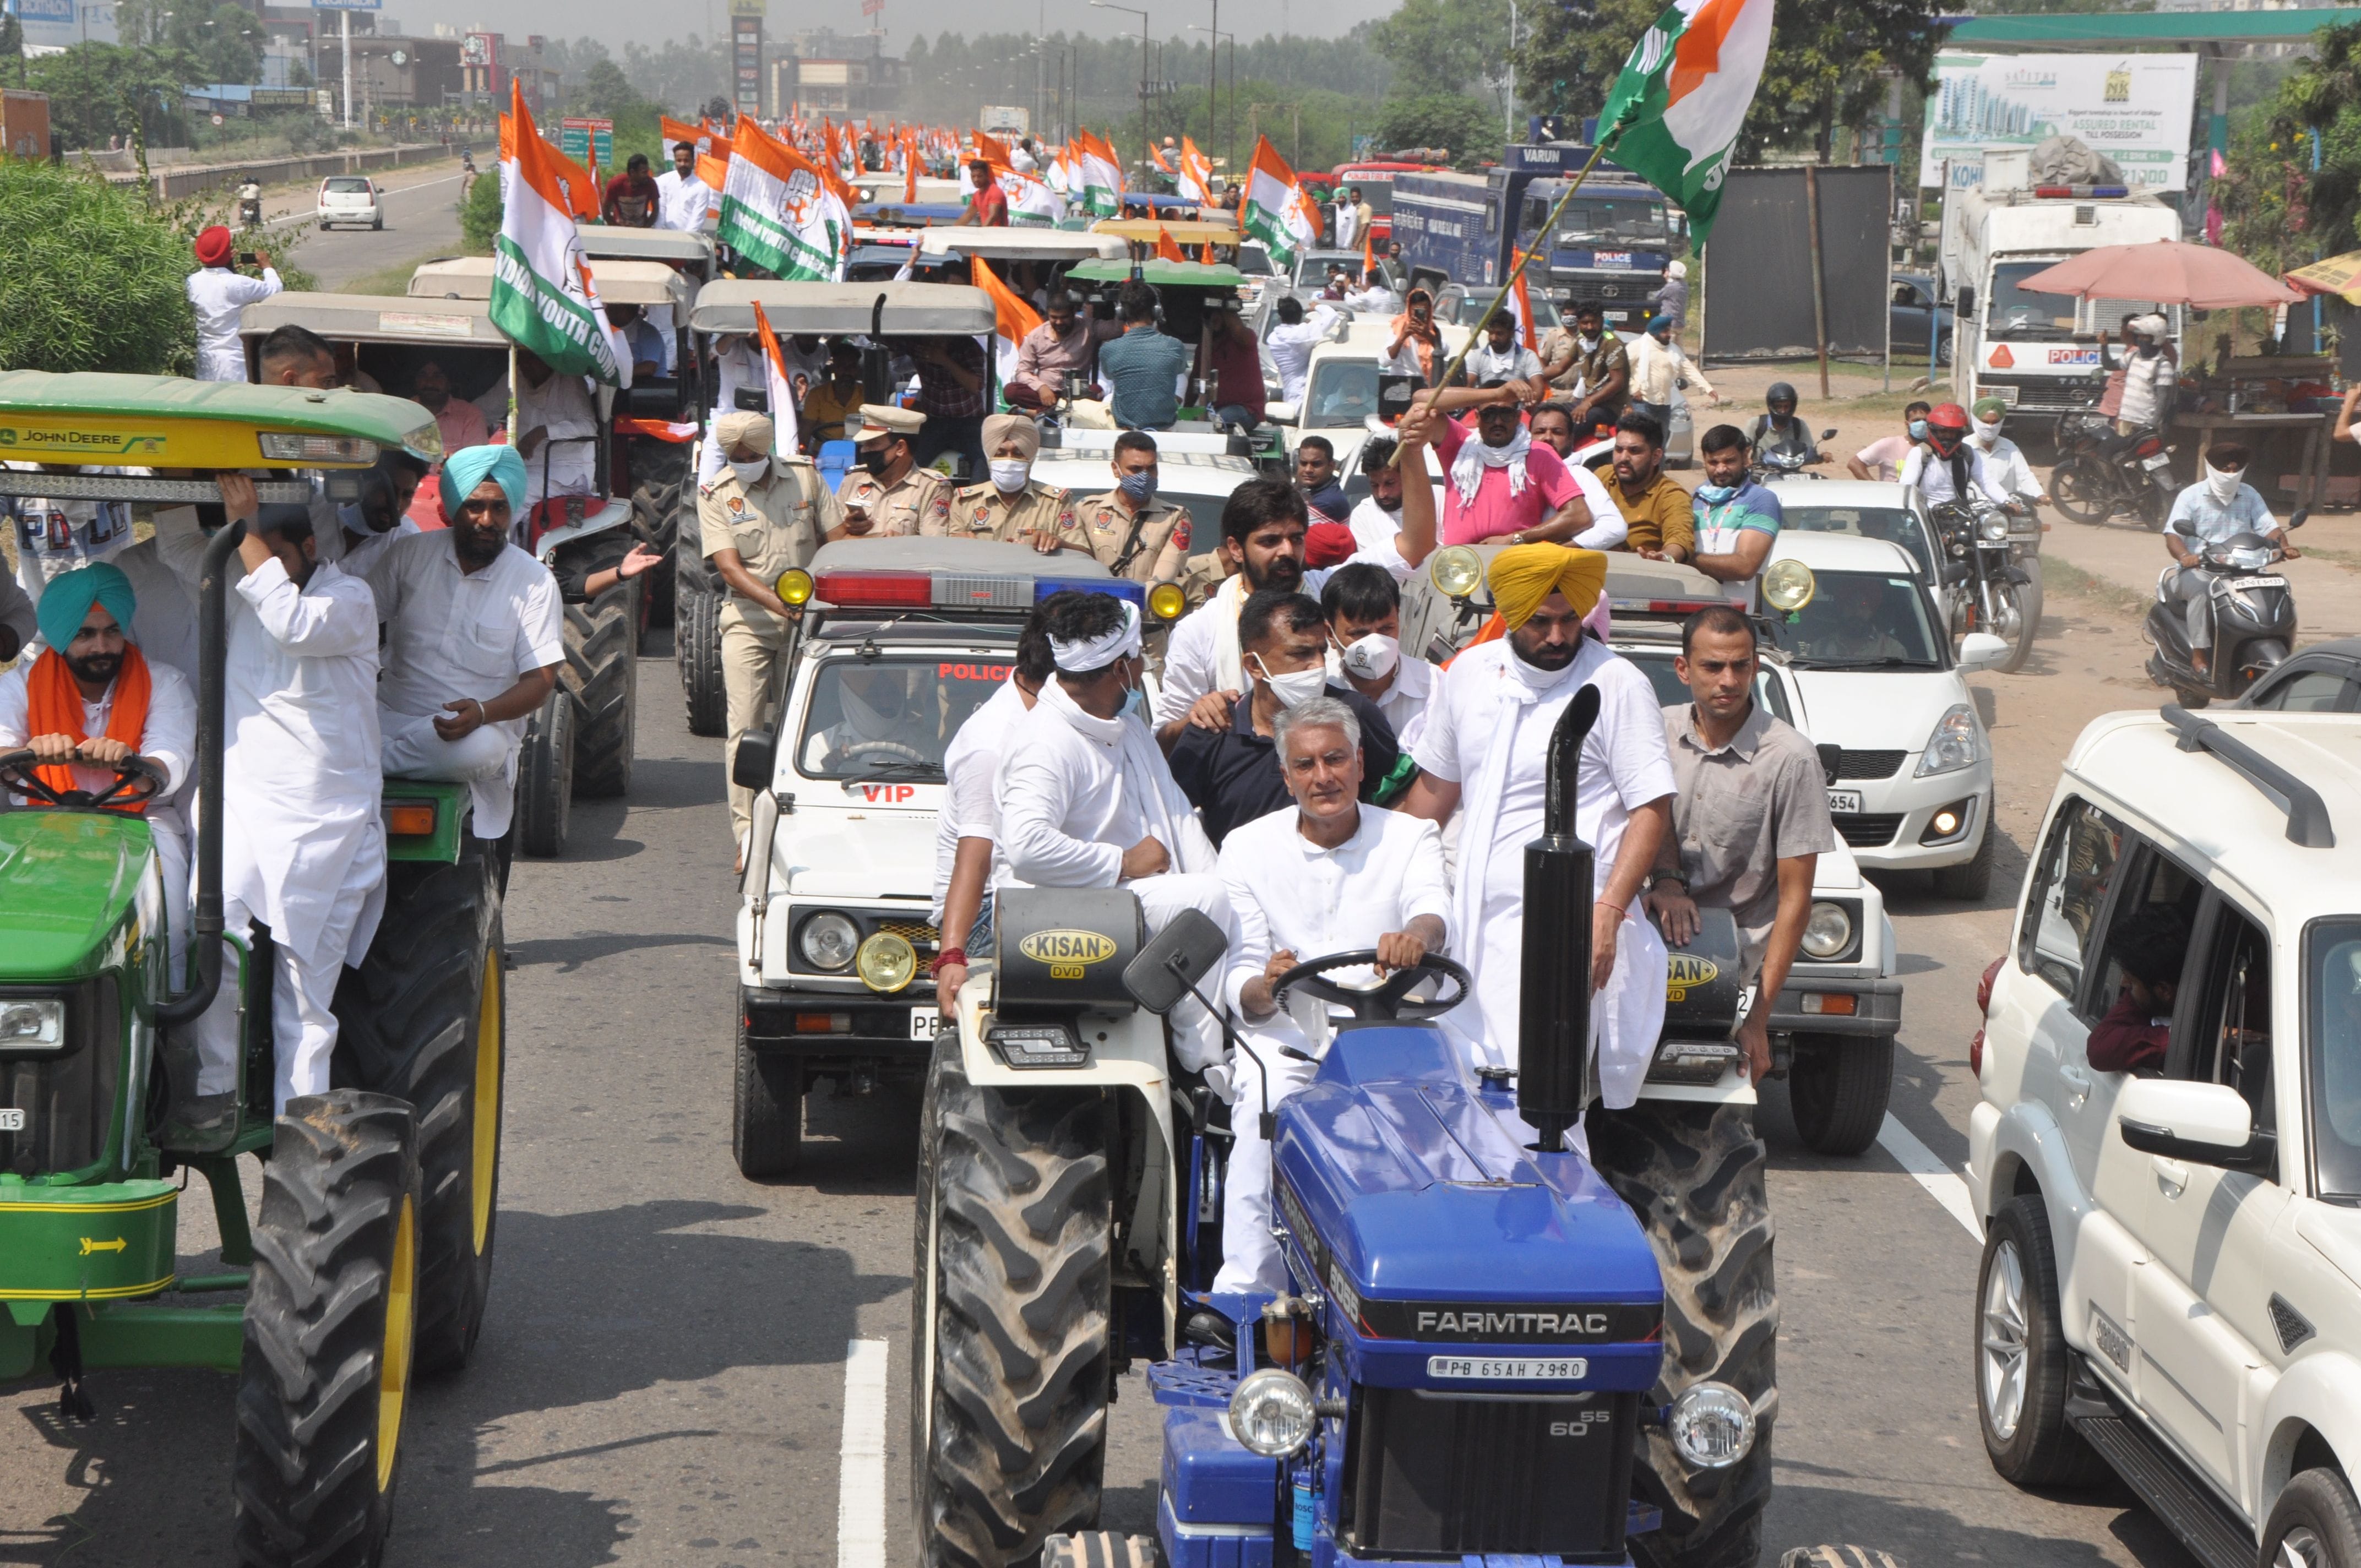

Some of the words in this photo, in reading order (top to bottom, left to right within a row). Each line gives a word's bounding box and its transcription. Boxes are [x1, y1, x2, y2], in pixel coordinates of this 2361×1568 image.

[2071, 119, 2117, 130] ASSURED
[2119, 120, 2156, 130] RENTAL
[1523, 149, 1560, 162] VARUN
[1594, 253, 1632, 263] POLICE
[536, 290, 591, 346] YOUTH
[23, 429, 66, 443] JOHN
[68, 432, 122, 445] DEERE
[862, 785, 915, 803] VIP
[1828, 796, 1856, 810] 654
[1036, 936, 1100, 958] KISAN
[1052, 966, 1082, 977] DVD
[2, 1113, 19, 1127] 15
[1281, 1183, 1319, 1266] FARMTRAC
[1330, 1263, 1359, 1324] 6055
[1417, 1311, 1608, 1333] FARMTRAC
[1451, 1362, 1472, 1376] PB
[1482, 1363, 1526, 1376] 65AH
[1536, 1363, 1580, 1376] 2980
[1550, 1422, 1588, 1436] 60
[1580, 1411, 1611, 1423] 55
